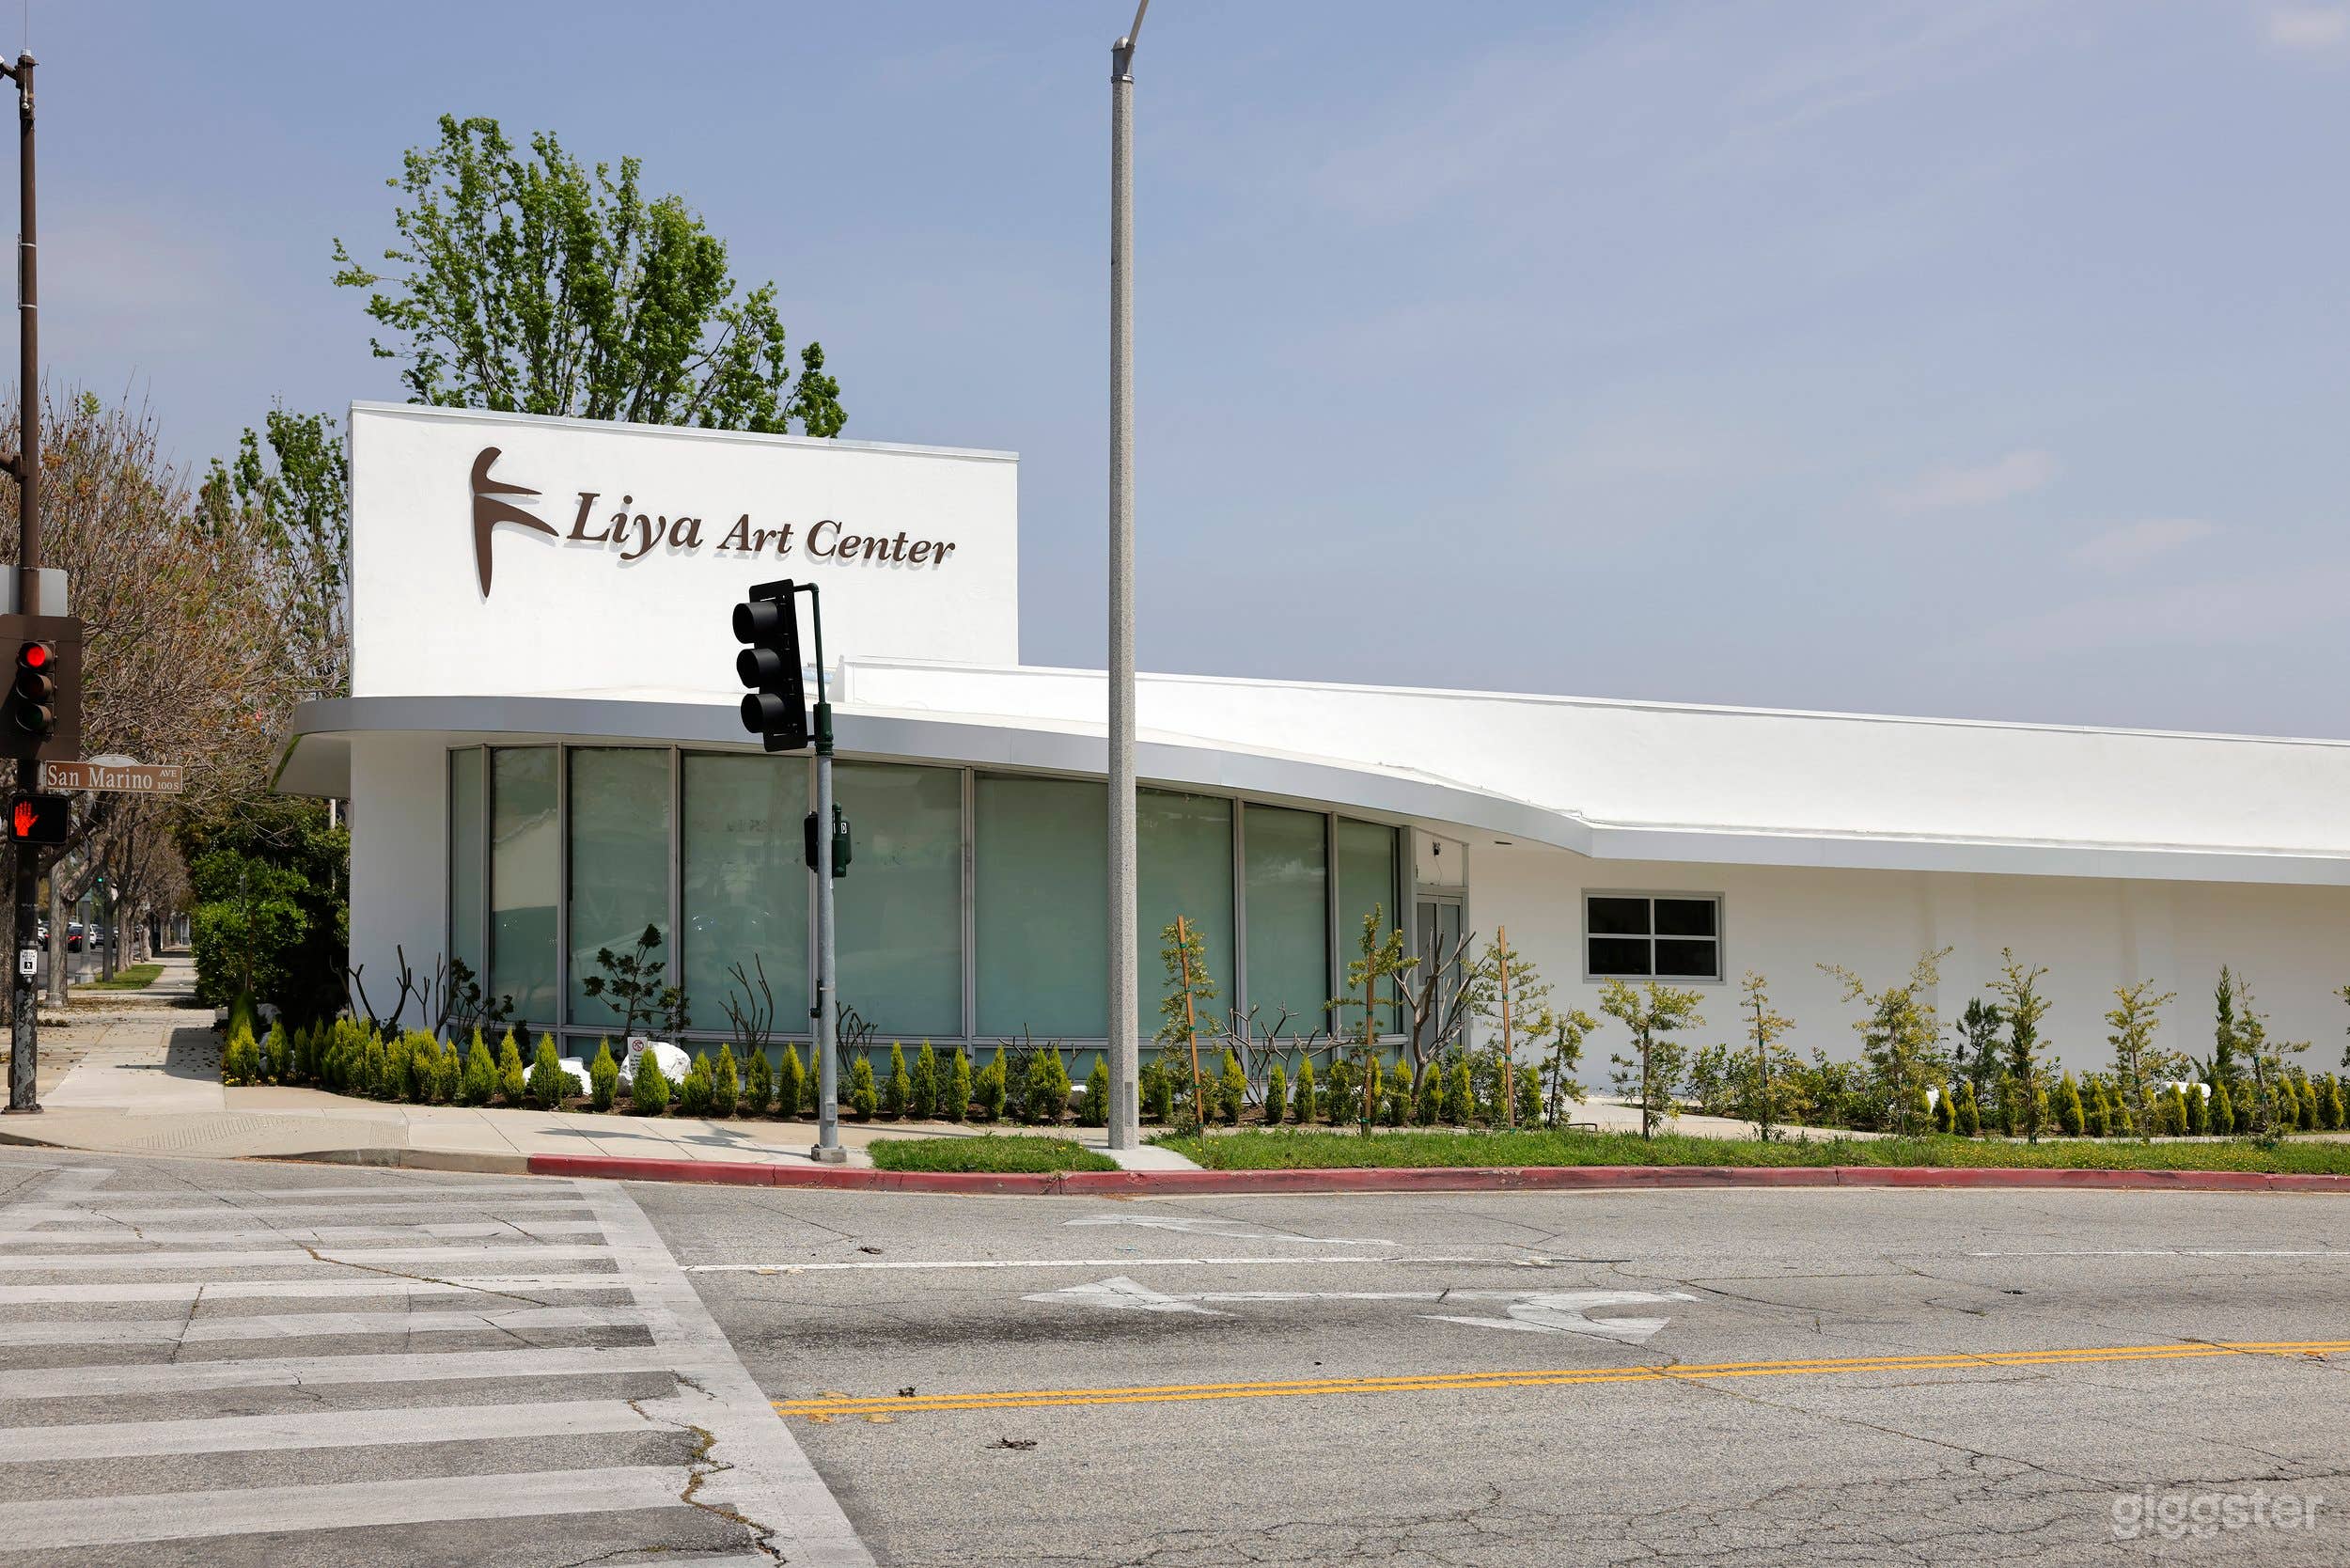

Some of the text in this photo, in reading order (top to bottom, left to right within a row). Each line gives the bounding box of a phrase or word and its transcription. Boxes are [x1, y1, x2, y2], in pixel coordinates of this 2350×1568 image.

[567, 492, 955, 564] Liya Art Center
[47, 764, 177, 789] San Marino AVE
